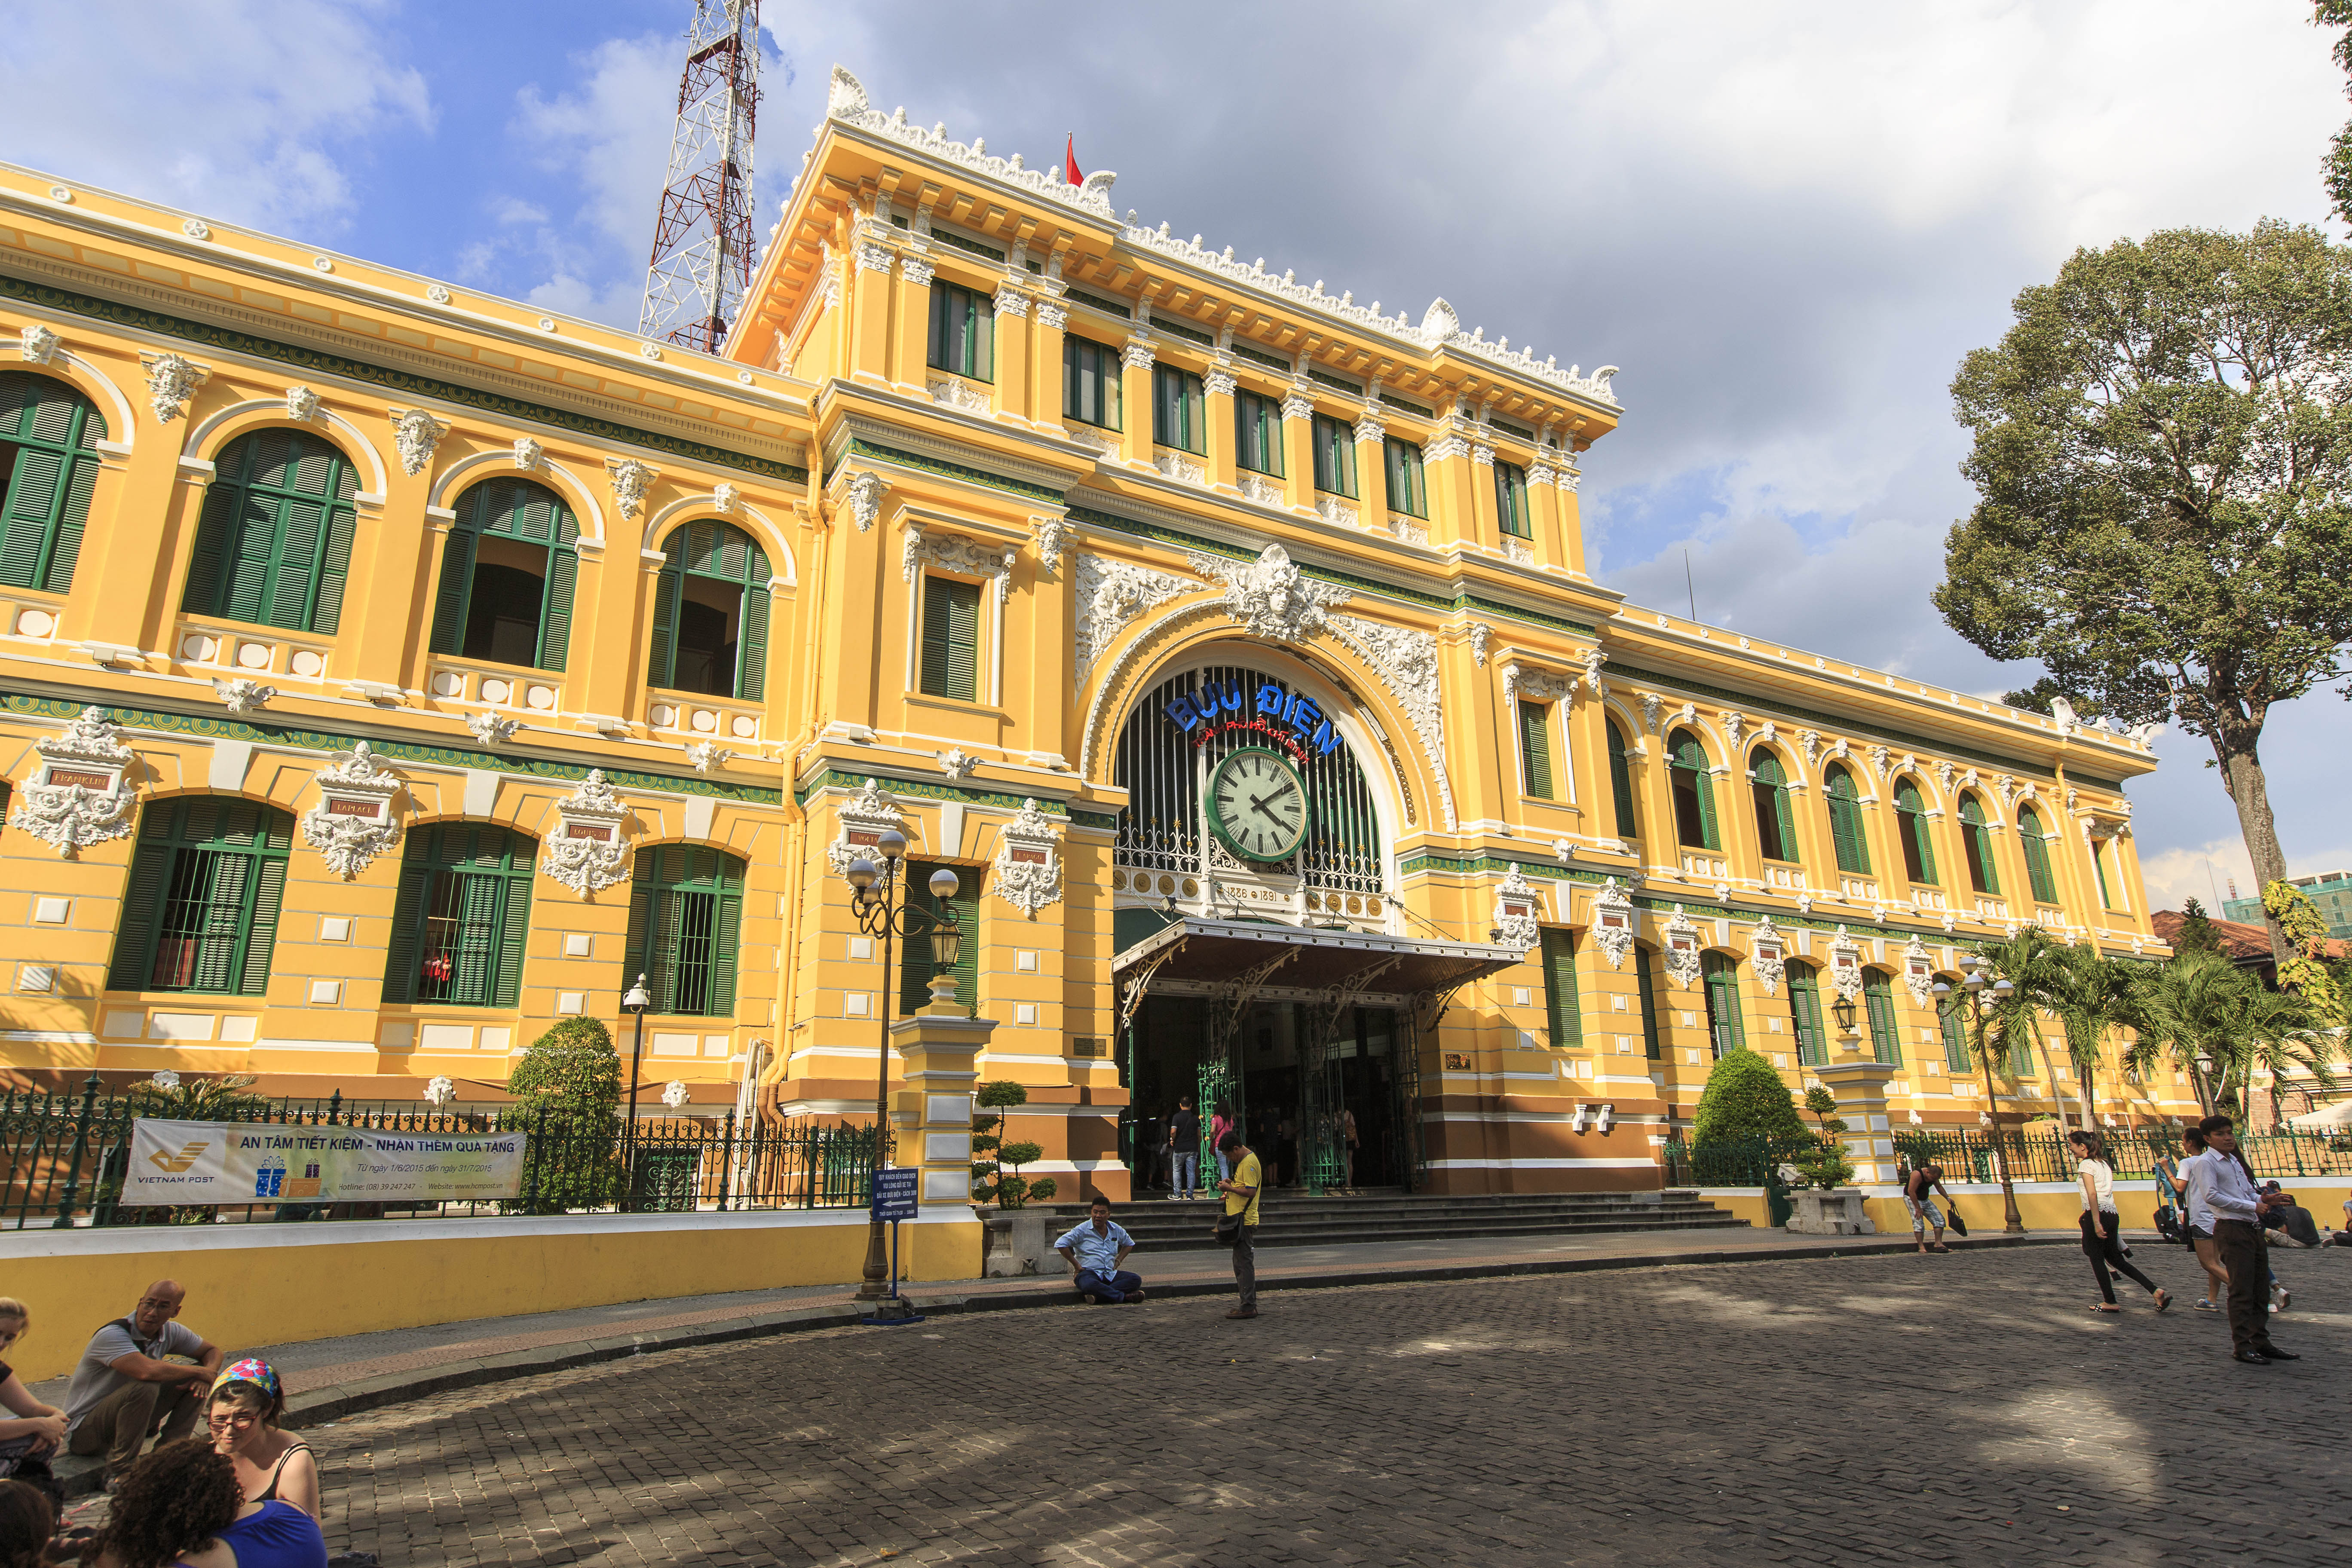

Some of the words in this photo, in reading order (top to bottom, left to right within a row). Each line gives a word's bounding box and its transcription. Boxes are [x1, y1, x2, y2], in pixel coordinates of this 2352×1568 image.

[1163, 679, 1241, 732] BƯU
[1256, 682, 1344, 757] ĐIỆN
[1285, 738, 1310, 765] MINH
[54, 774, 106, 786] FRANKLIN
[337, 804, 372, 814] LAPLACE
[574, 828, 596, 836] LOUIS
[1227, 887, 1247, 898] 1886
[1260, 890, 1277, 901] 1891
[240, 1136, 260, 1148] AN
[265, 1135, 294, 1149] TÂM
[297, 1135, 327, 1149] TIẾT
[329, 1136, 363, 1152] KIỆM
[377, 1139, 414, 1152] NHẬN
[417, 1140, 453, 1152] THÊM
[456, 1140, 482, 1152] QUÀ
[485, 1141, 514, 1154] TẶNG
[357, 1163, 368, 1172] Từ
[369, 1164, 388, 1173] ngày
[391, 1164, 424, 1172] 1/6/2015
[425, 1164, 438, 1172] đến
[440, 1165, 457, 1173] ngày
[458, 1164, 492, 1173] 31/7/2015
[366, 1183, 379, 1191] (08)
